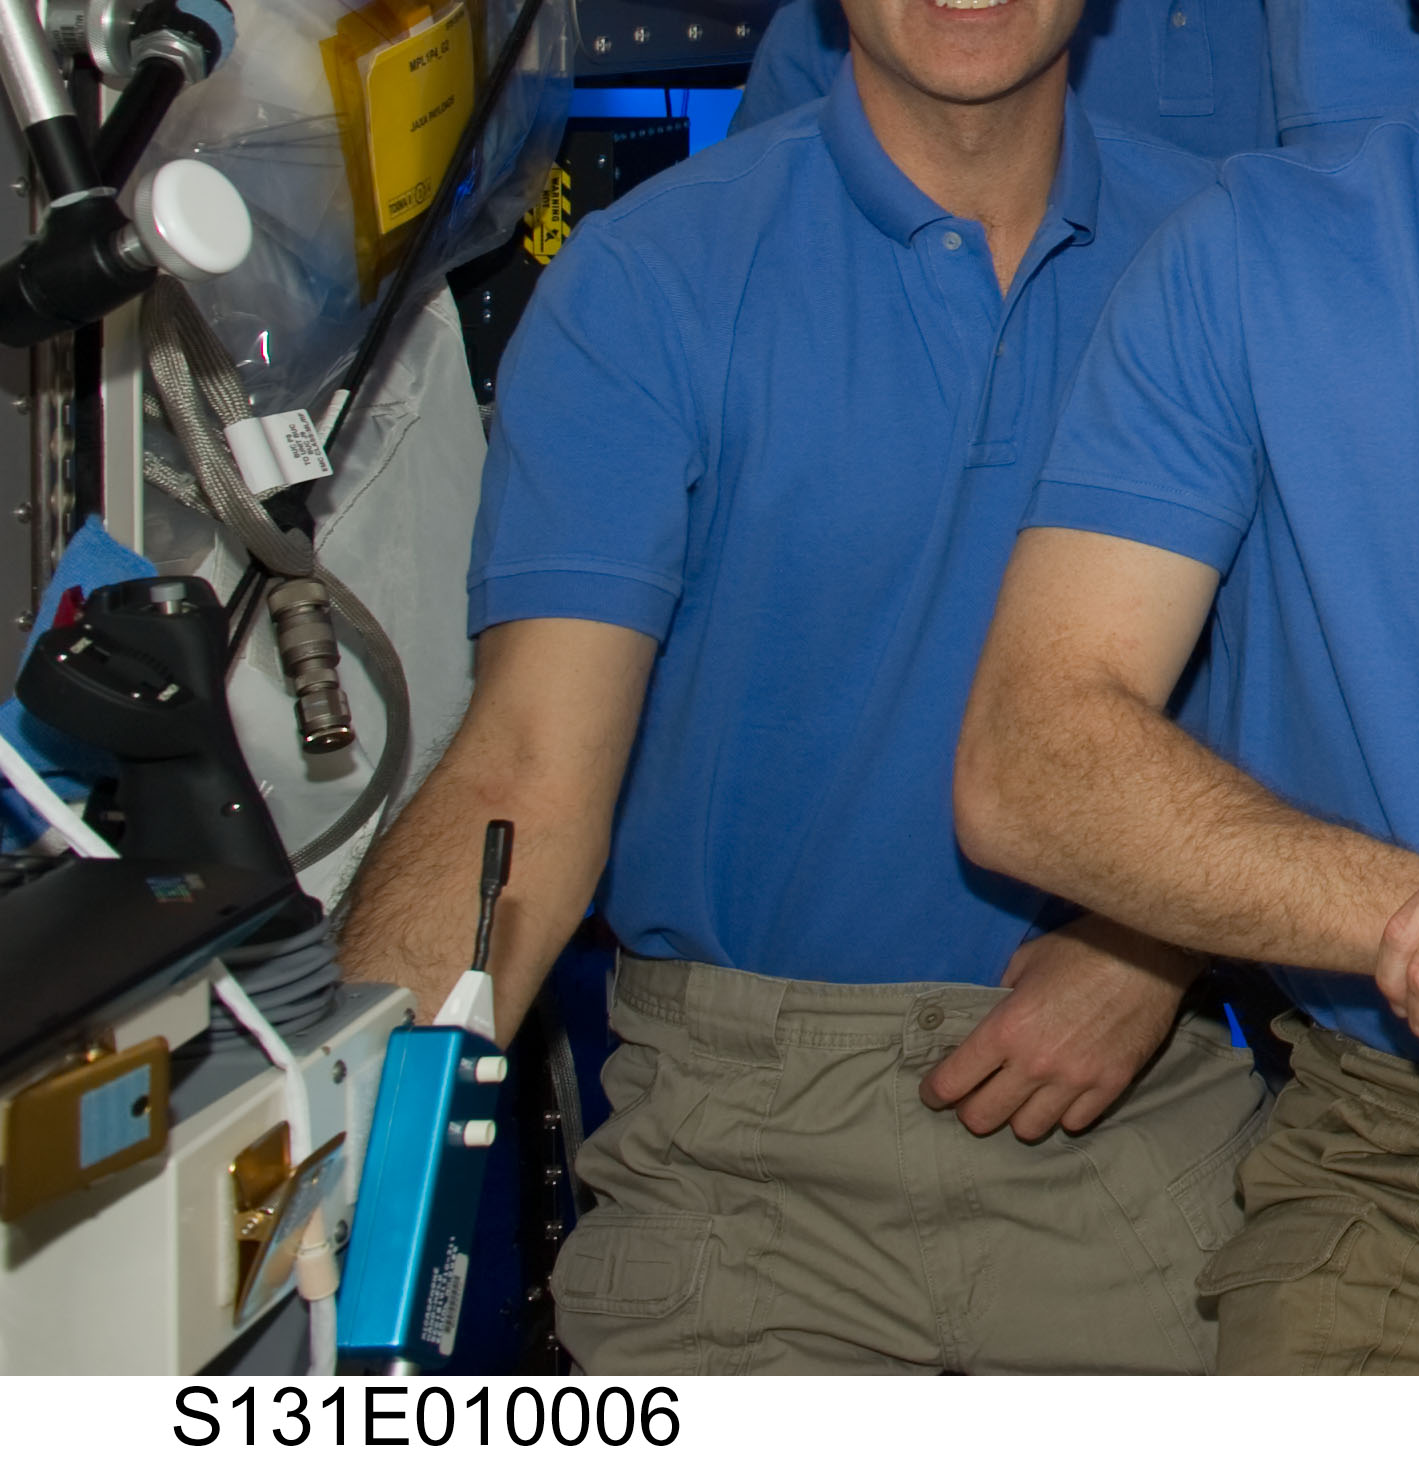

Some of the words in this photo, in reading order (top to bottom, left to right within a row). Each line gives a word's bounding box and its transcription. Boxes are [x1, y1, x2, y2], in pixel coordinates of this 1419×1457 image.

[407, 112, 429, 133] JAXA
[551, 176, 559, 222] WARNING
[288, 422, 299, 438] BUC
[288, 443, 300, 458] BUC
[295, 438, 306, 455] UNIT
[302, 440, 314, 455] BUC
[301, 455, 311, 466] TO
[316, 455, 328, 473] EMC
